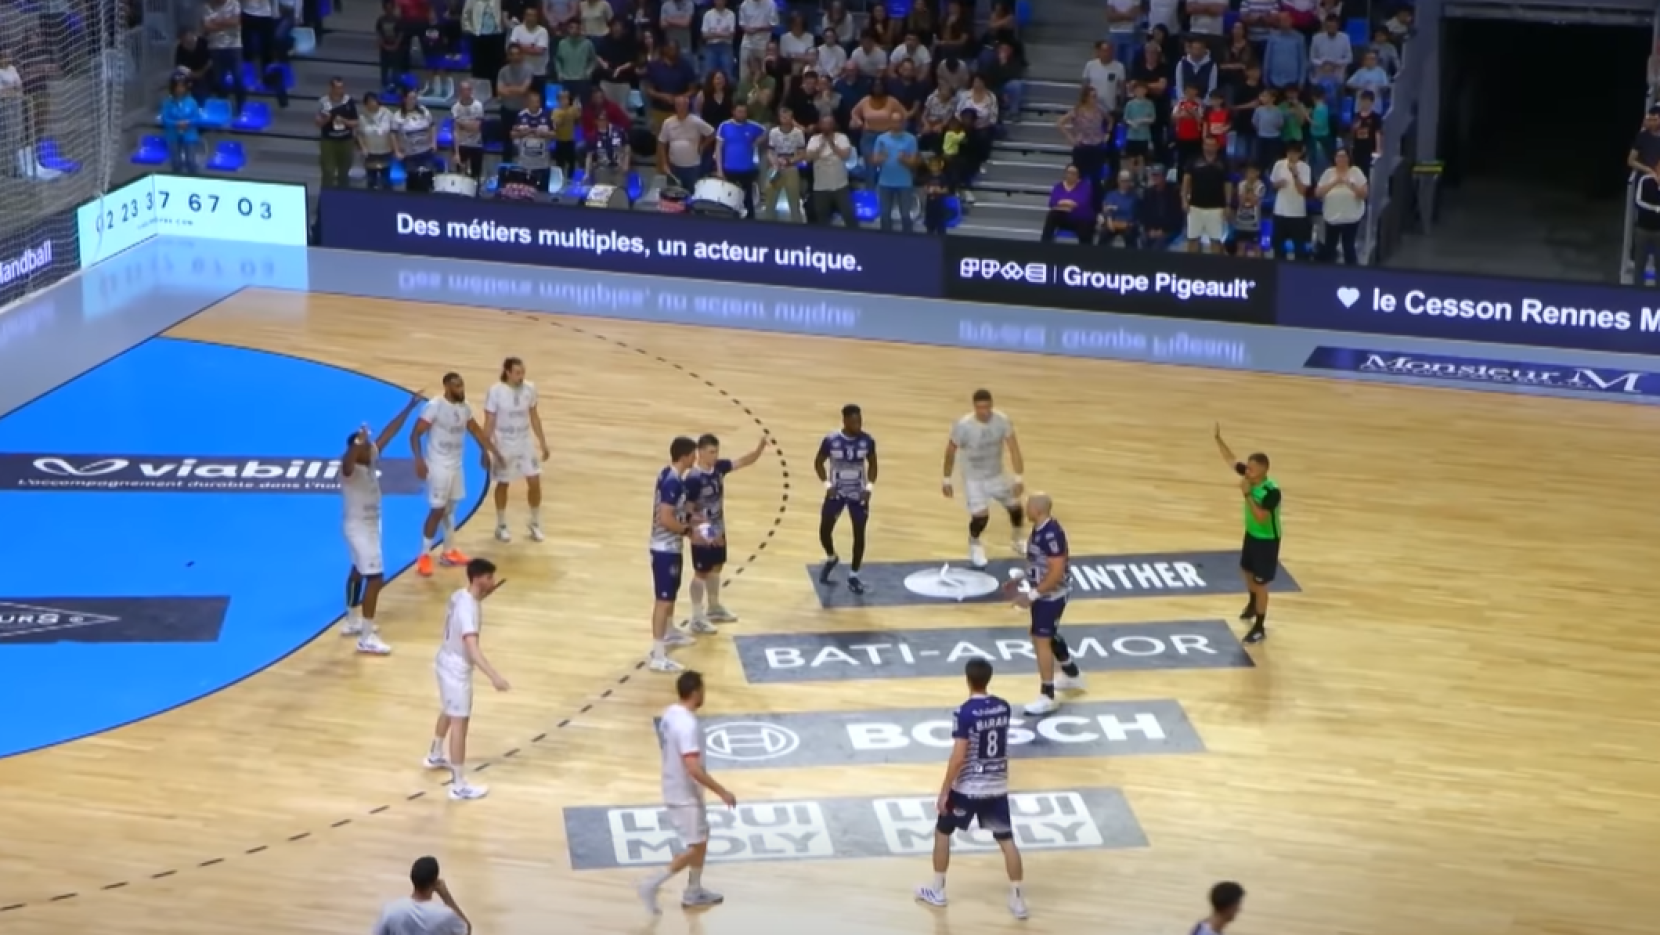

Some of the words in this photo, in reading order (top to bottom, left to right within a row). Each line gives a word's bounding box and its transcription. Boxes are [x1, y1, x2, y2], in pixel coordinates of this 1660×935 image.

[121, 198, 139, 223] 23
[188, 193, 220, 213] 67
[237, 198, 272, 220] 03
[396, 213, 440, 236] Des
[447, 219, 532, 244] métiers
[538, 227, 651, 258] multiples,
[658, 239, 687, 256] un
[694, 241, 769, 263] acteur
[774, 246, 864, 273] unique.
[1063, 264, 1149, 294] Groupe
[1373, 287, 1397, 312] le
[1404, 289, 1512, 322] Cesson
[1521, 298, 1631, 329] Rennes
[1364, 353, 1561, 381] Monsieur
[1568, 367, 1647, 393] M
[138, 458, 382, 478] viabili
[764, 634, 1218, 669] BATI-ARMOR
[987, 730, 998, 757] 8
[886, 796, 1077, 821] LIUI
